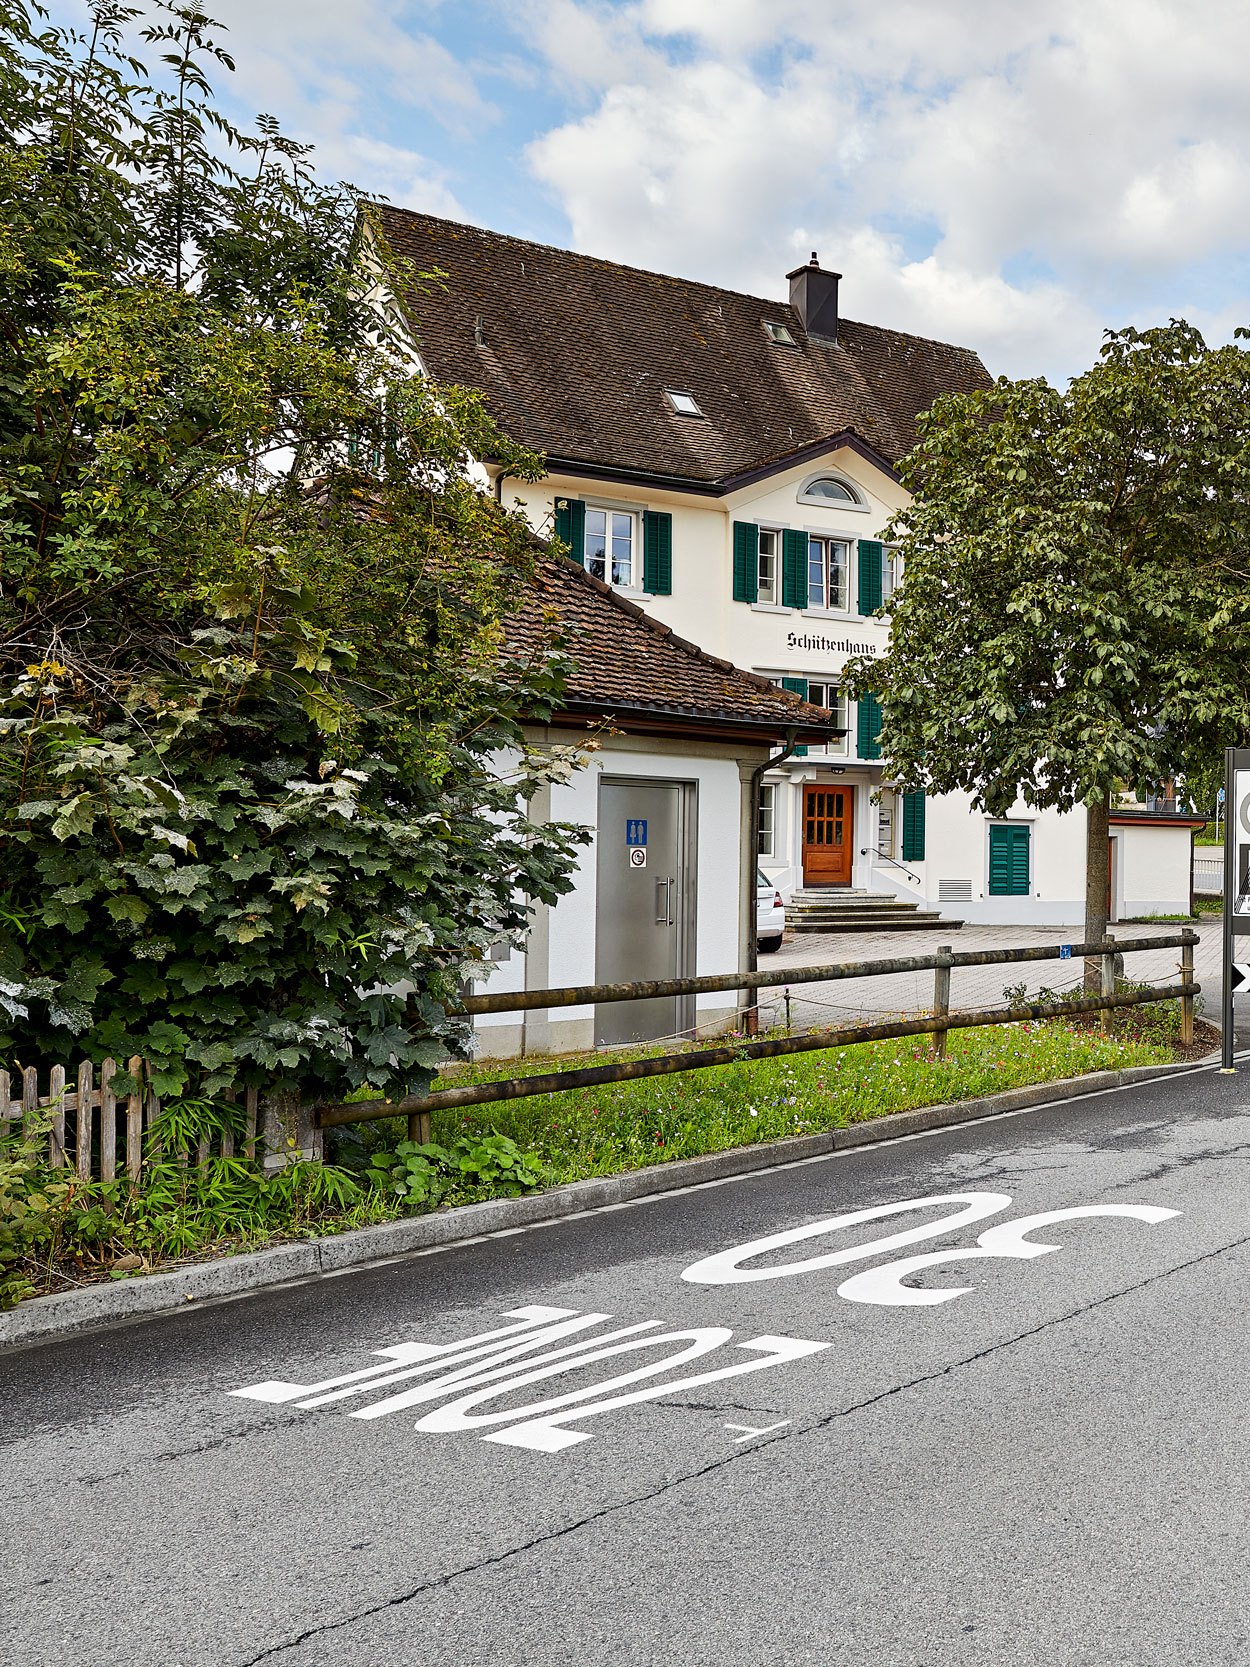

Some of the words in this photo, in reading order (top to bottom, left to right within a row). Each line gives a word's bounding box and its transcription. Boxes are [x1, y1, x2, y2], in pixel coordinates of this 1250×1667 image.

[787, 632, 876, 655] Schützenhaus
[680, 1192, 1184, 1307] 30
[227, 1304, 833, 1453] ZONE
